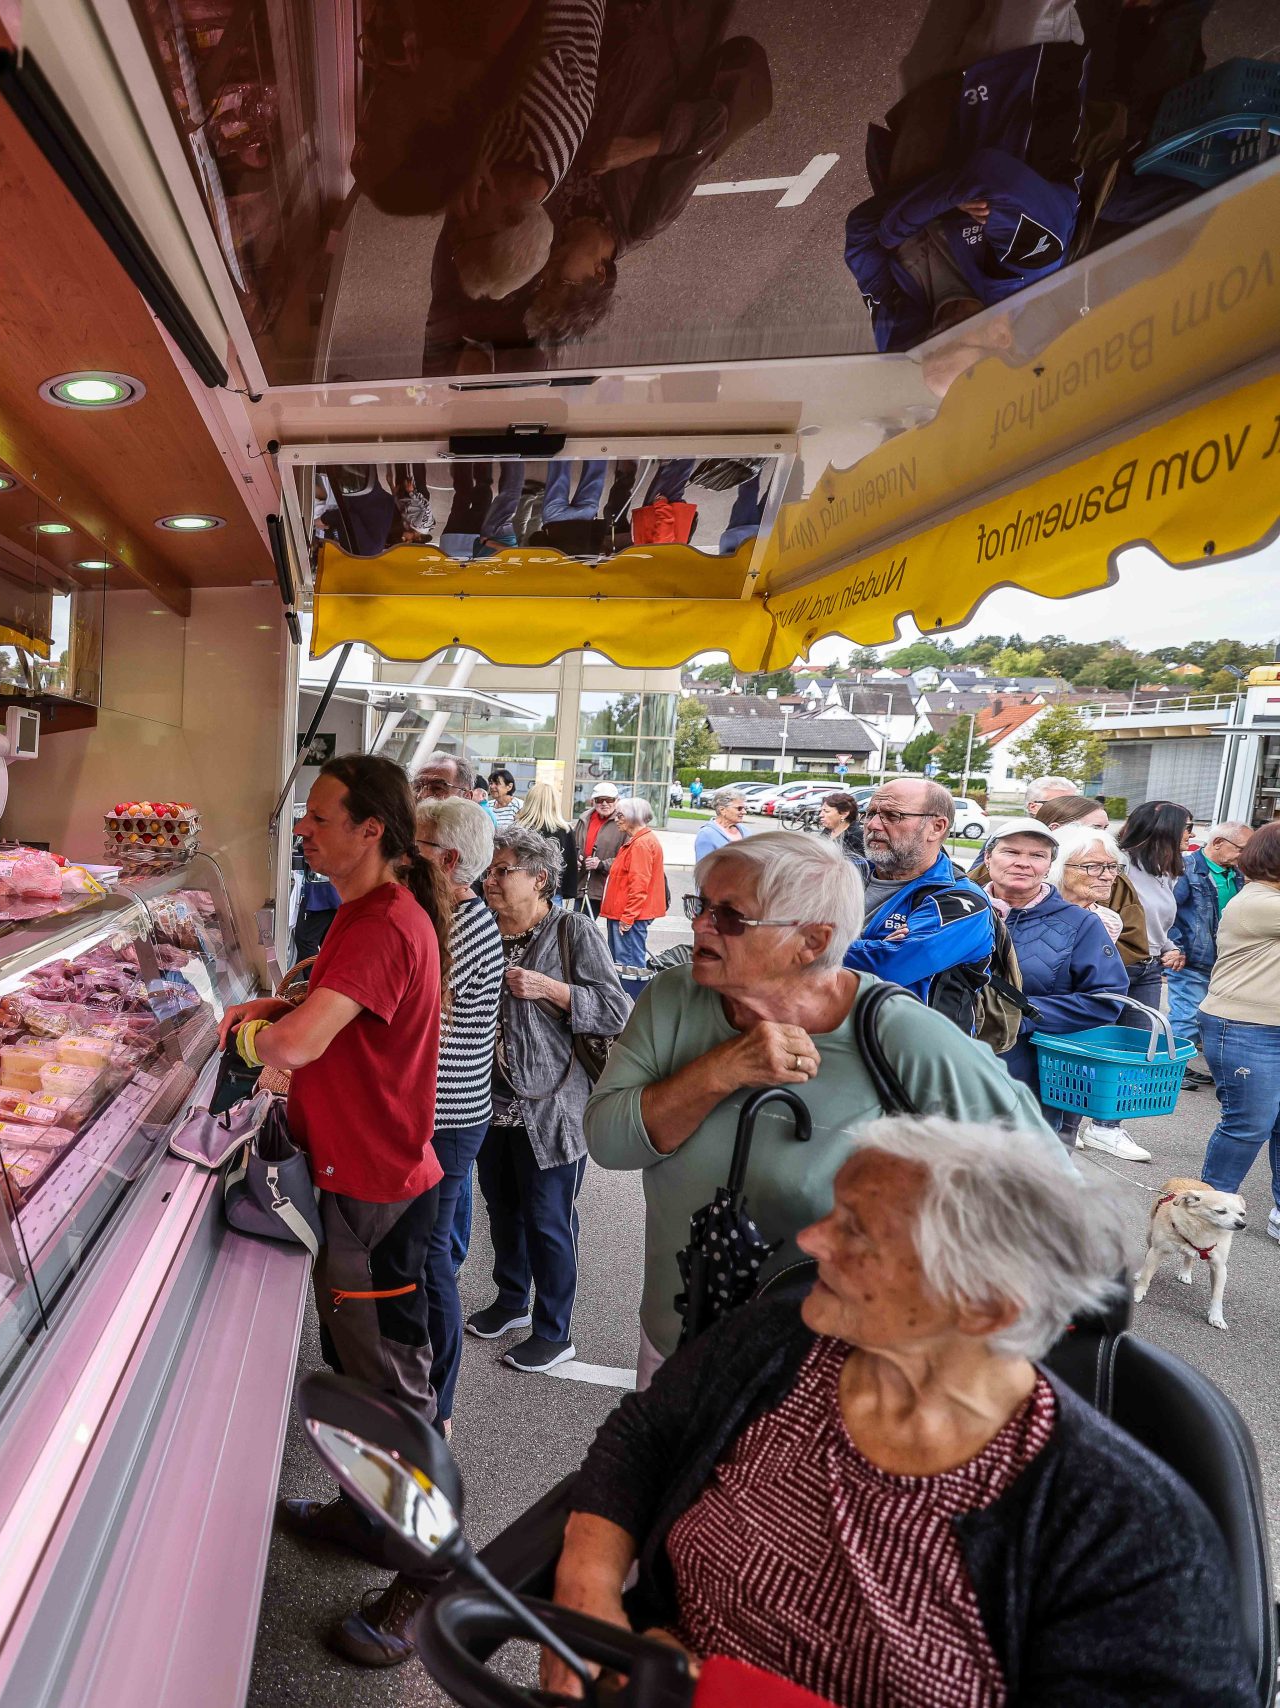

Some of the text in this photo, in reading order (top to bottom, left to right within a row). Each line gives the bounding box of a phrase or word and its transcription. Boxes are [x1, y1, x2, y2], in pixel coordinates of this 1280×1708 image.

[988, 249, 1275, 451] vom Bauernhof
[852, 456, 917, 517] Nudeln
